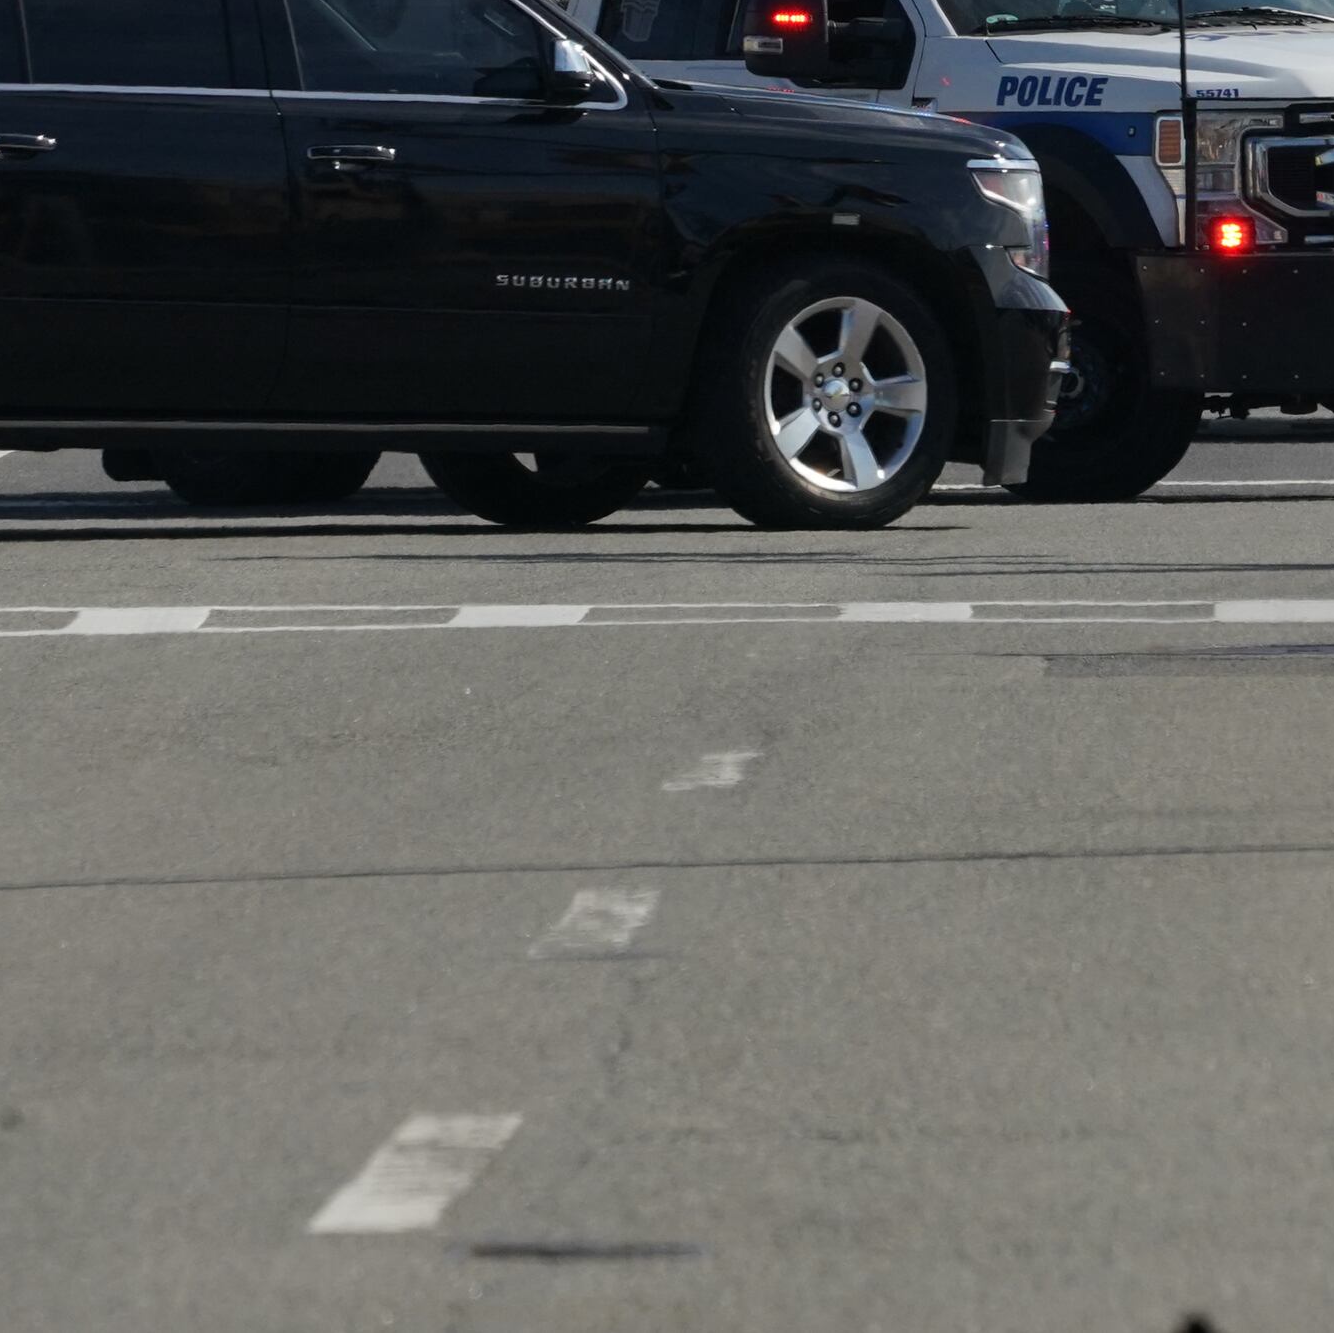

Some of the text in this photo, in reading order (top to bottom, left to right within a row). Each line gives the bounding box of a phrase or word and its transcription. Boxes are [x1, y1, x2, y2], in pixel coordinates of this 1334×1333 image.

[996, 75, 1109, 108] POLICE
[1195, 88, 1240, 99] 55741
[496, 275, 630, 291] SUBURBAN
